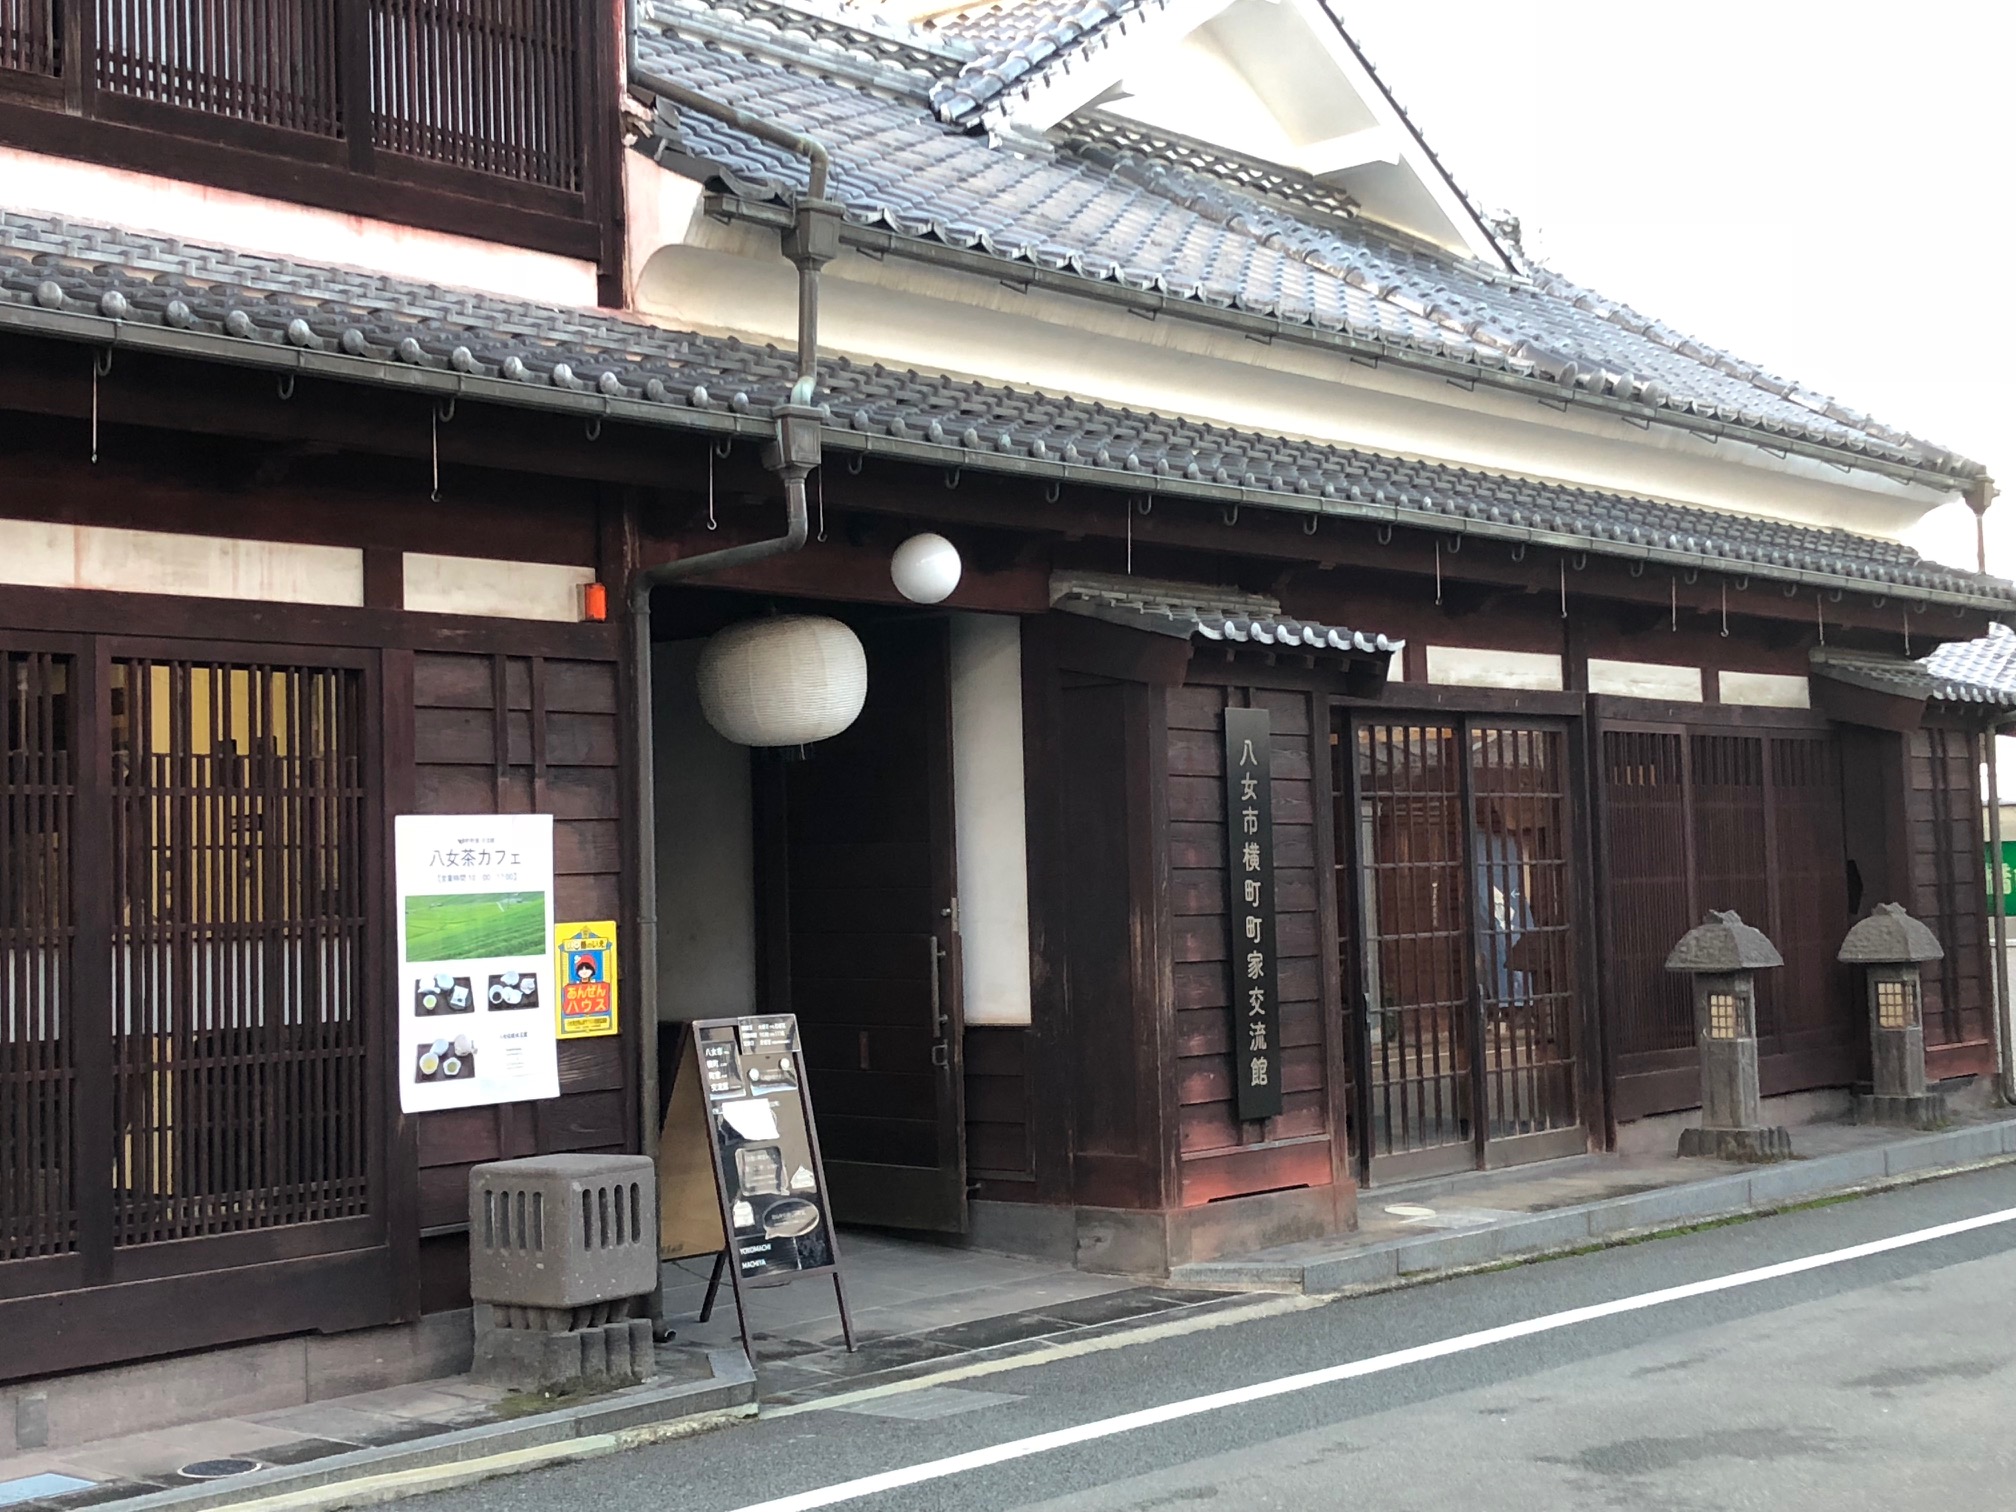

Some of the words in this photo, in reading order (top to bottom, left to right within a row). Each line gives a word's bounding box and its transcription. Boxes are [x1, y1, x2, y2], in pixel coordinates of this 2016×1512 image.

[429, 849, 521, 867] 八女茶カフェ
[1239, 739, 1269, 1086] 八女市横町町家交流館
[567, 985, 606, 1000] あんぜん
[566, 999, 607, 1013] ハウス
